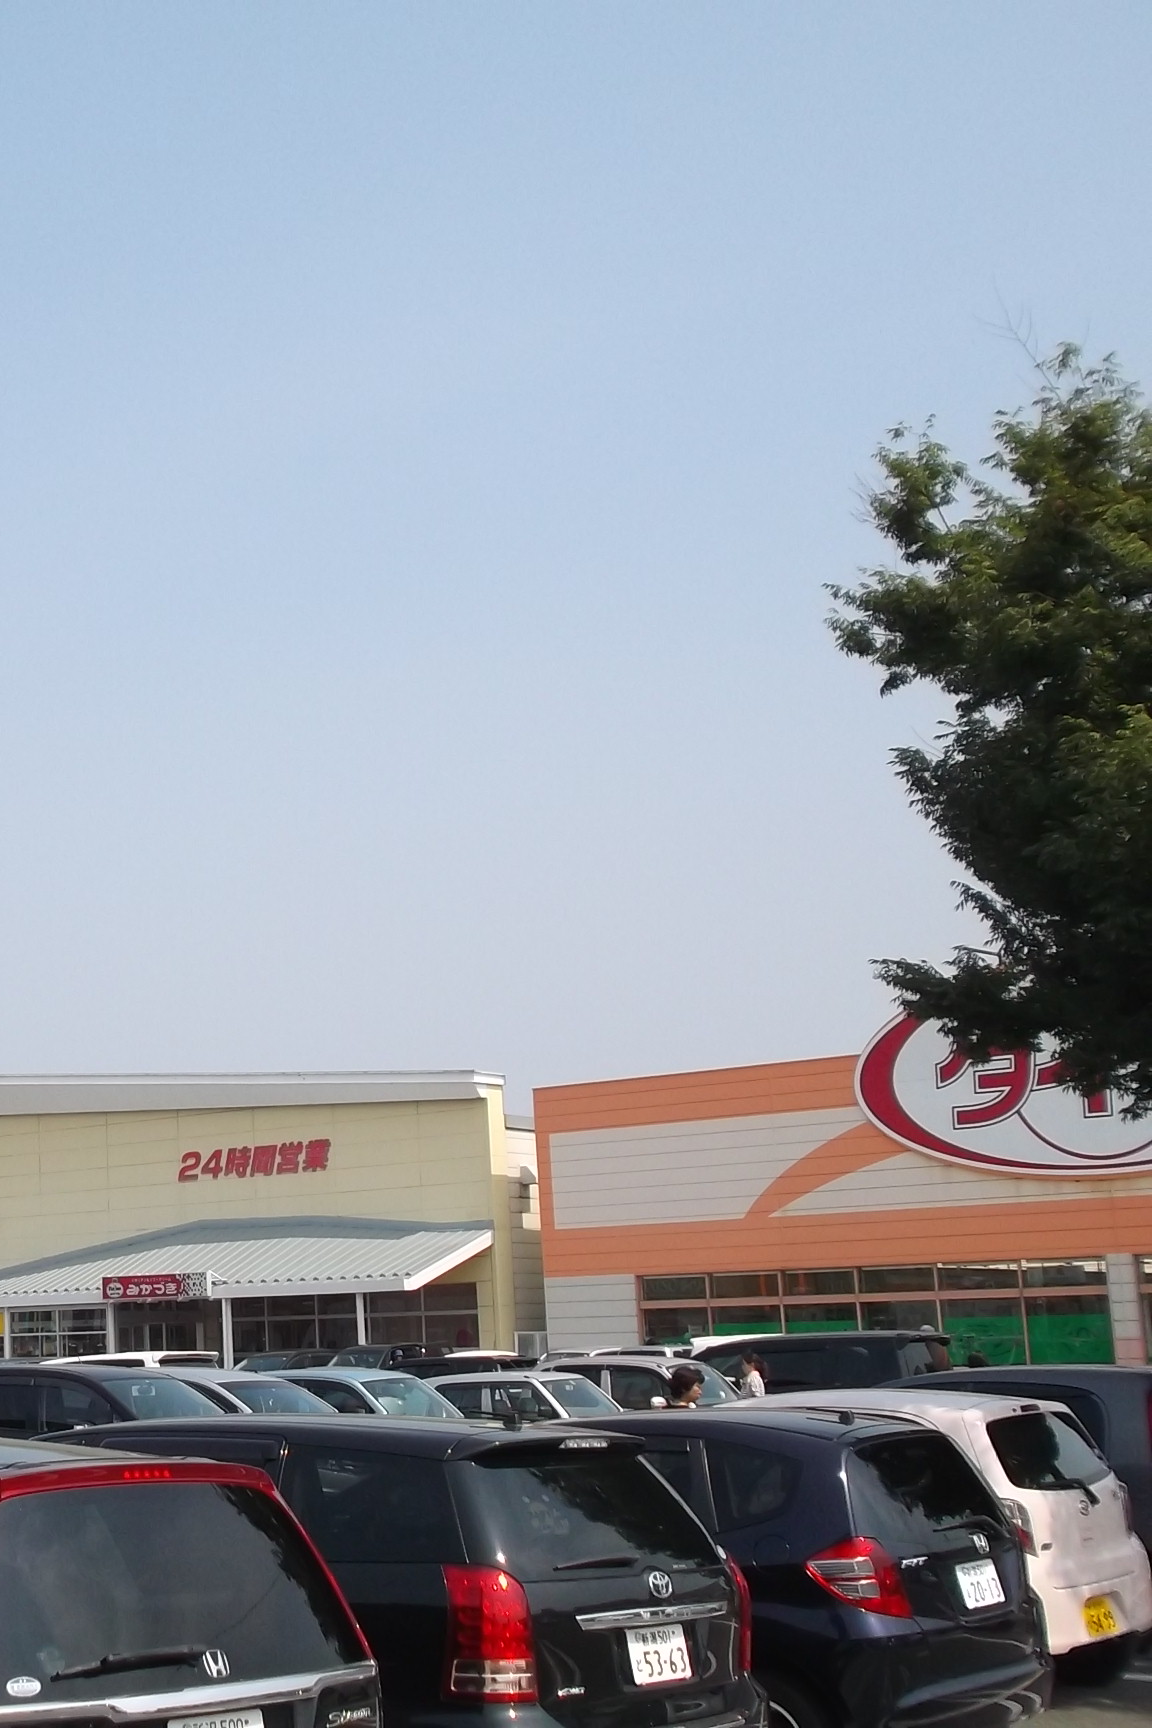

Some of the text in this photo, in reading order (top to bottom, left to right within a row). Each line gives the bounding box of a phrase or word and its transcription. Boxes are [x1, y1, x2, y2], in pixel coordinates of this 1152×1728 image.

[178, 1138, 331, 1183] 24時間営業
[126, 1282, 177, 1296] みかづき
[643, 1647, 687, 1678] 53-63
